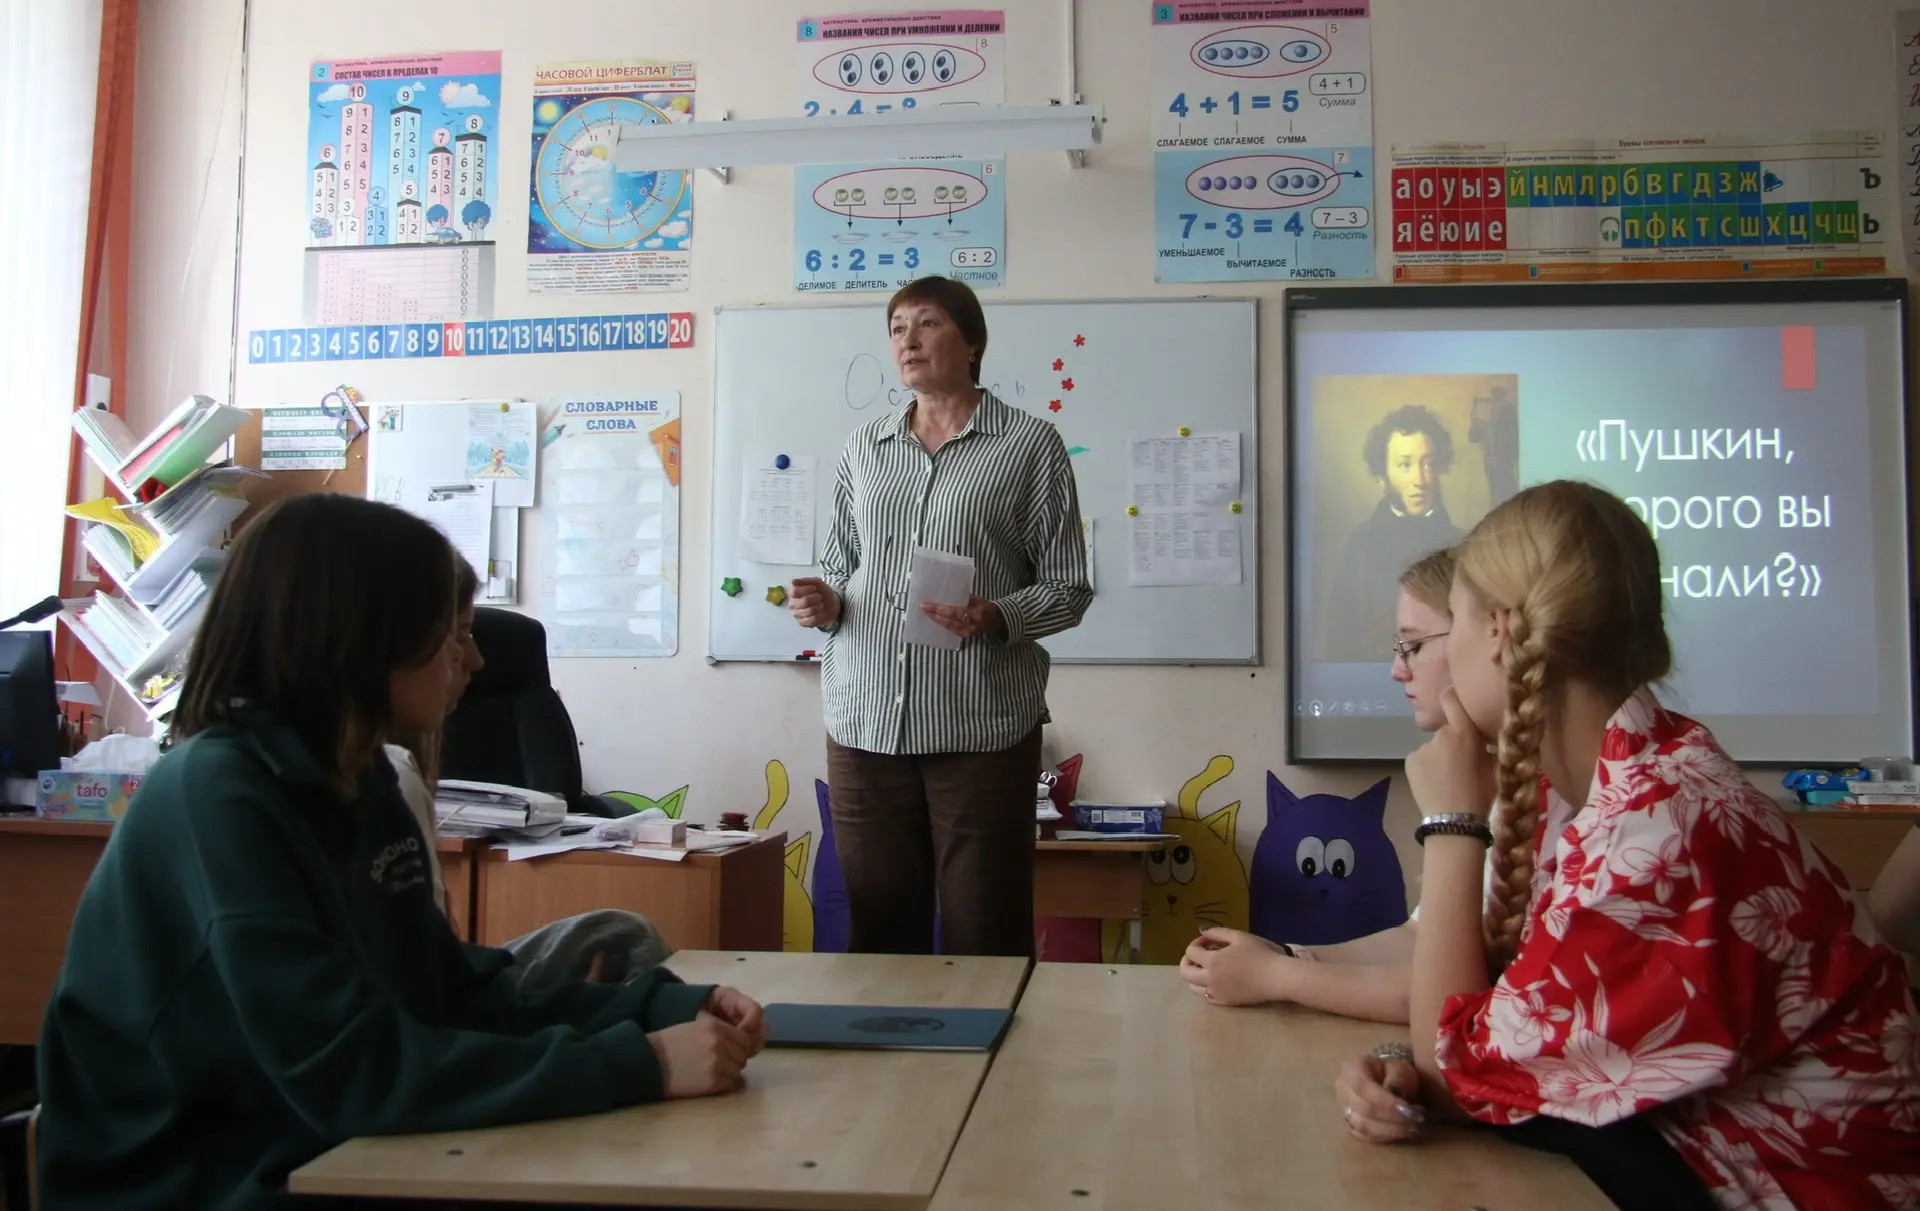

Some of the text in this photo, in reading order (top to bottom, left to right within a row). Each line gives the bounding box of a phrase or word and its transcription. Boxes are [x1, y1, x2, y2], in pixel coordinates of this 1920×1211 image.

[1161, 10, 1168, 19] 3
[805, 26, 813, 37] 8
[823, 24, 1000, 38] НАЗВАНИЯ ЧИСЕЛ ПРИ УМНОЖЕНИИ И ДЕЛЕНИИ
[1331, 24, 1338, 34] 5
[981, 39, 988, 48] 8
[319, 69, 325, 78] 2
[536, 67, 593, 80] ЧАСОВОЙ
[596, 66, 667, 79] ЦИФЕРБЛАТ
[1319, 79, 1328, 90] 4
[1347, 78, 1353, 89] 1
[351, 86, 364, 98] 10
[403, 92, 410, 101] 9
[804, 101, 820, 117] 2
[847, 100, 864, 115] 4
[1170, 93, 1189, 118] 4
[1228, 91, 1240, 115] 1
[1283, 90, 1299, 113] 5
[1319, 98, 1356, 108] Сумма
[471, 119, 478, 129] 8
[439, 133, 445, 144] 7
[589, 134, 598, 142] 11
[1157, 136, 1307, 148] СЛАГАЕМОЕ СЛАГАЕМОЕ СУММА
[324, 148, 331, 159] 6
[1338, 153, 1345, 162] 7
[986, 165, 993, 174] 6
[406, 185, 413, 195] 5
[1396, 168, 1881, 206] а о у ы э й н м л р б в г д з ж ъ
[374, 191, 380, 201] 4
[344, 201, 351, 212] 3
[1323, 213, 1331, 224] 7
[1349, 213, 1358, 224] 3
[1179, 214, 1197, 239] 7
[1225, 213, 1244, 239] 3
[1284, 212, 1304, 237] 4
[1397, 212, 1880, 247] я ё ю и е п ф к т с ш х ц ч щ ь
[1313, 230, 1368, 241] Разность
[958, 252, 966, 263] 6
[984, 252, 992, 263] 2
[1159, 248, 1225, 258] УМЕНЬШАЕМОЕ
[806, 250, 821, 272] 6
[849, 249, 866, 271] 2
[904, 248, 920, 269] 3
[1227, 259, 1287, 269] ВЫЧИТАЕМОЕ
[950, 271, 998, 281] Частное
[1291, 268, 1336, 278] РАЗНОСТЬ
[798, 281, 837, 291] ДЕЛИМОЕ
[845, 280, 888, 290] ДЕЛИТЕЛЬ
[254, 319, 691, 358] 0 1 2 3 4 5 6 7 8 9 10 11 12 13 14 15 16 17 18 19 20
[565, 401, 658, 414] СЛОВАРНЫЕ
[586, 419, 637, 431] СЛОВА
[1576, 419, 1795, 473] «Пушкин,
[1778, 495, 1832, 528] вы
[1661, 552, 1823, 599] нали?»
[77, 783, 109, 798] tafo
